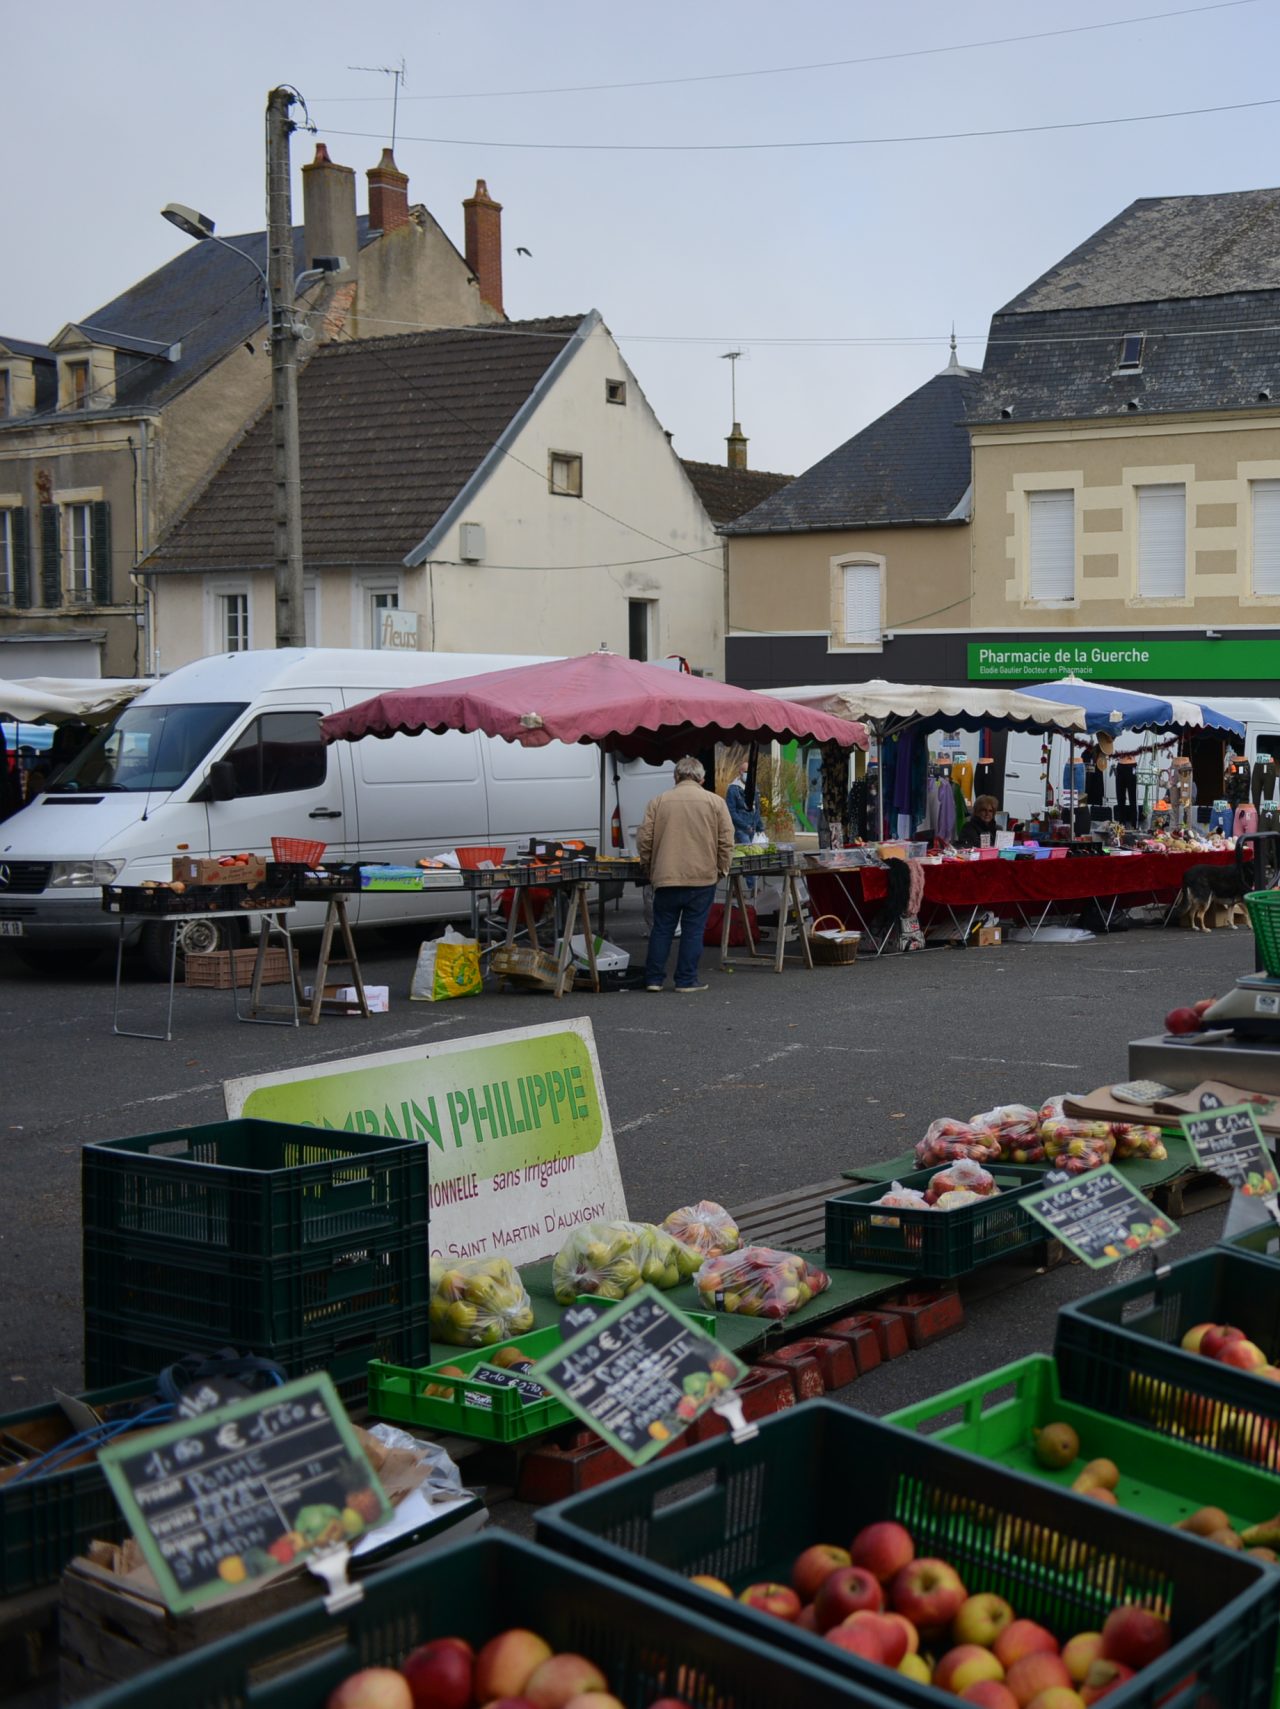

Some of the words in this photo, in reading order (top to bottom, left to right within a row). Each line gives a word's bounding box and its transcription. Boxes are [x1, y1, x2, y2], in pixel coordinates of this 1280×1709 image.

[382, 615, 416, 649] fleurs
[979, 648, 1051, 664] Pharmacie
[1054, 648, 1071, 663] de
[1074, 648, 1087, 663] la
[1091, 647, 1149, 663] Guerche
[979, 665, 999, 675] Elodie
[999, 665, 1023, 675] Gautier
[1023, 665, 1048, 675] Docteur
[1058, 665, 1093, 674] Pharmacie
[447, 1065, 590, 1149] PHILIPPE
[429, 1172, 479, 1208] IONNELLE
[492, 1165, 521, 1192] sans
[524, 1153, 576, 1189] irrigation
[491, 1222, 541, 1250] MARTIN
[544, 1201, 606, 1234] D'AUXIGNY
[598, 1330, 622, 1351] €
[178, 1386, 220, 1420] 1kg
[215, 1422, 247, 1451] €
